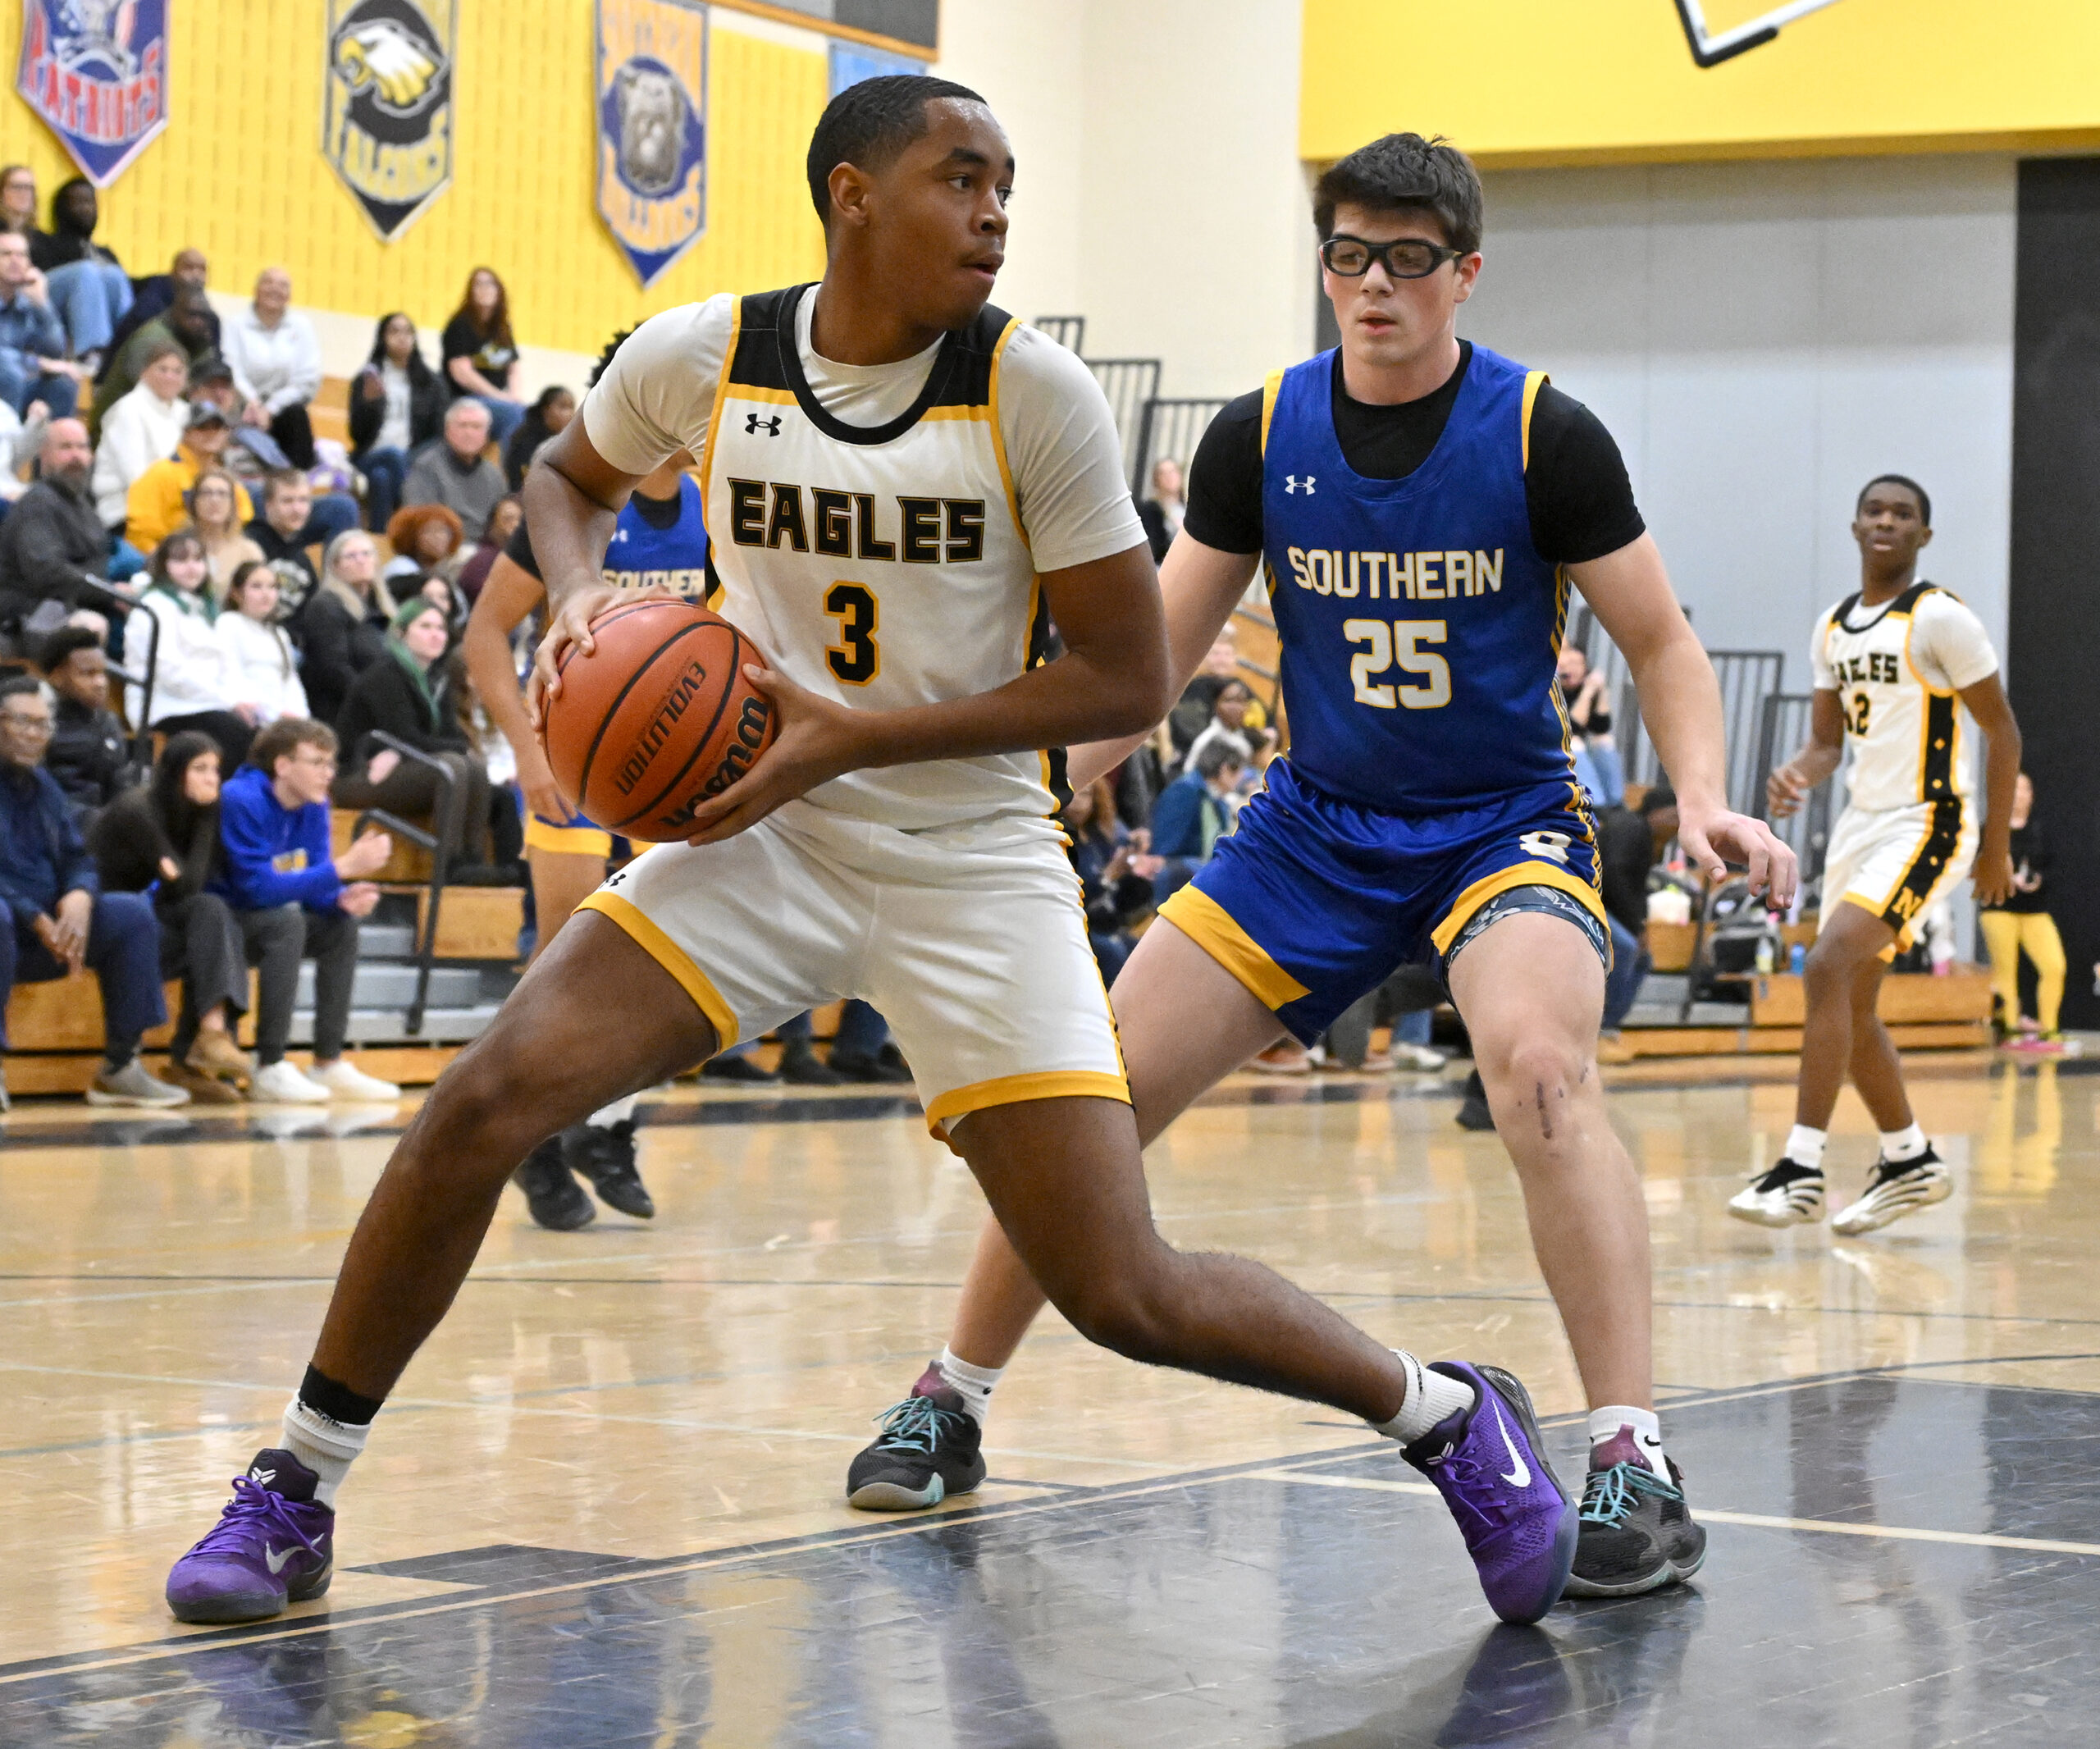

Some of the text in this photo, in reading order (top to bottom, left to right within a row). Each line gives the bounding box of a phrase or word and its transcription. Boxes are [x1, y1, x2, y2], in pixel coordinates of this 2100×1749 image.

[727, 477, 985, 564] EAGLES
[1287, 546, 1504, 600] SOUTHERN
[823, 580, 881, 687] 3
[1343, 619, 1452, 709] 25
[616, 661, 706, 796] EVOLUTION
